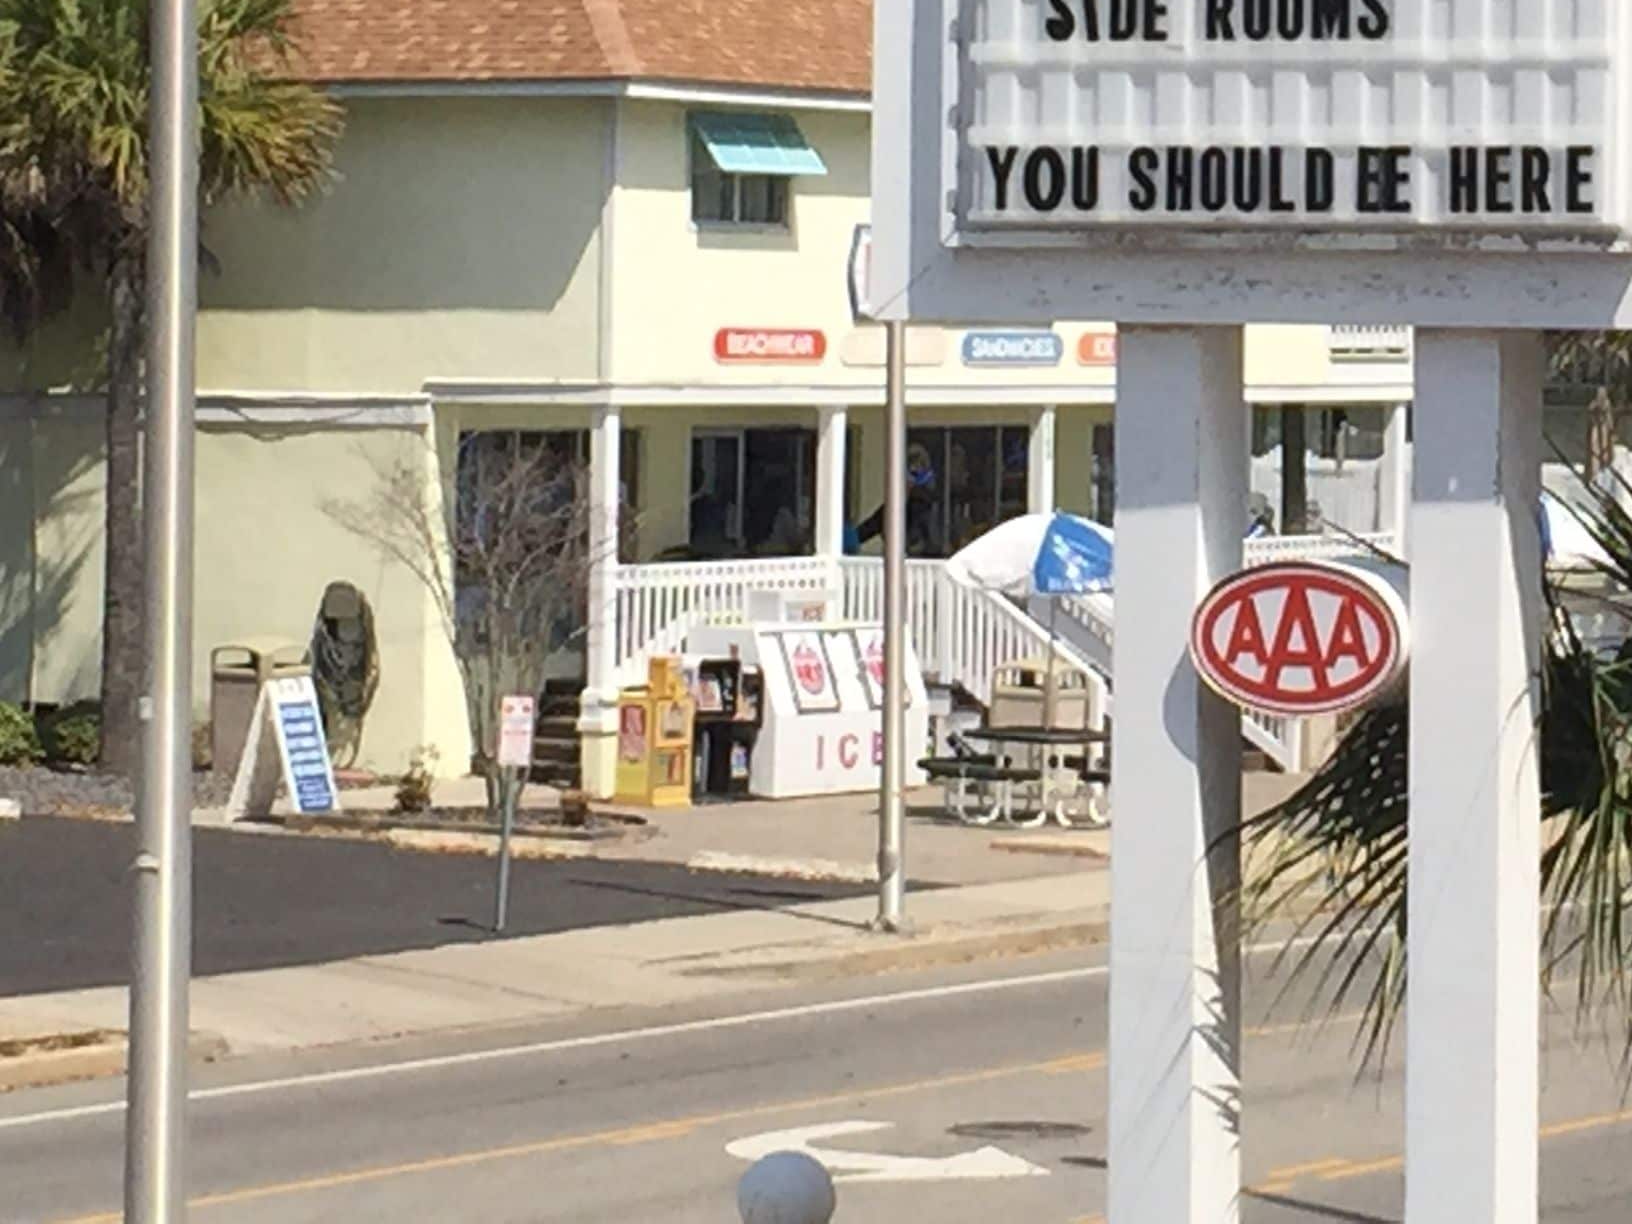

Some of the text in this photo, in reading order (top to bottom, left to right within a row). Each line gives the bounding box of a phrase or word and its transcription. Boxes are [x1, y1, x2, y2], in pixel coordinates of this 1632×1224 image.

[987, 147, 1099, 212] YOU
[1128, 147, 1334, 213] SHOULD
[1449, 147, 1593, 213] HERE
[1225, 582, 1371, 691] AAA
